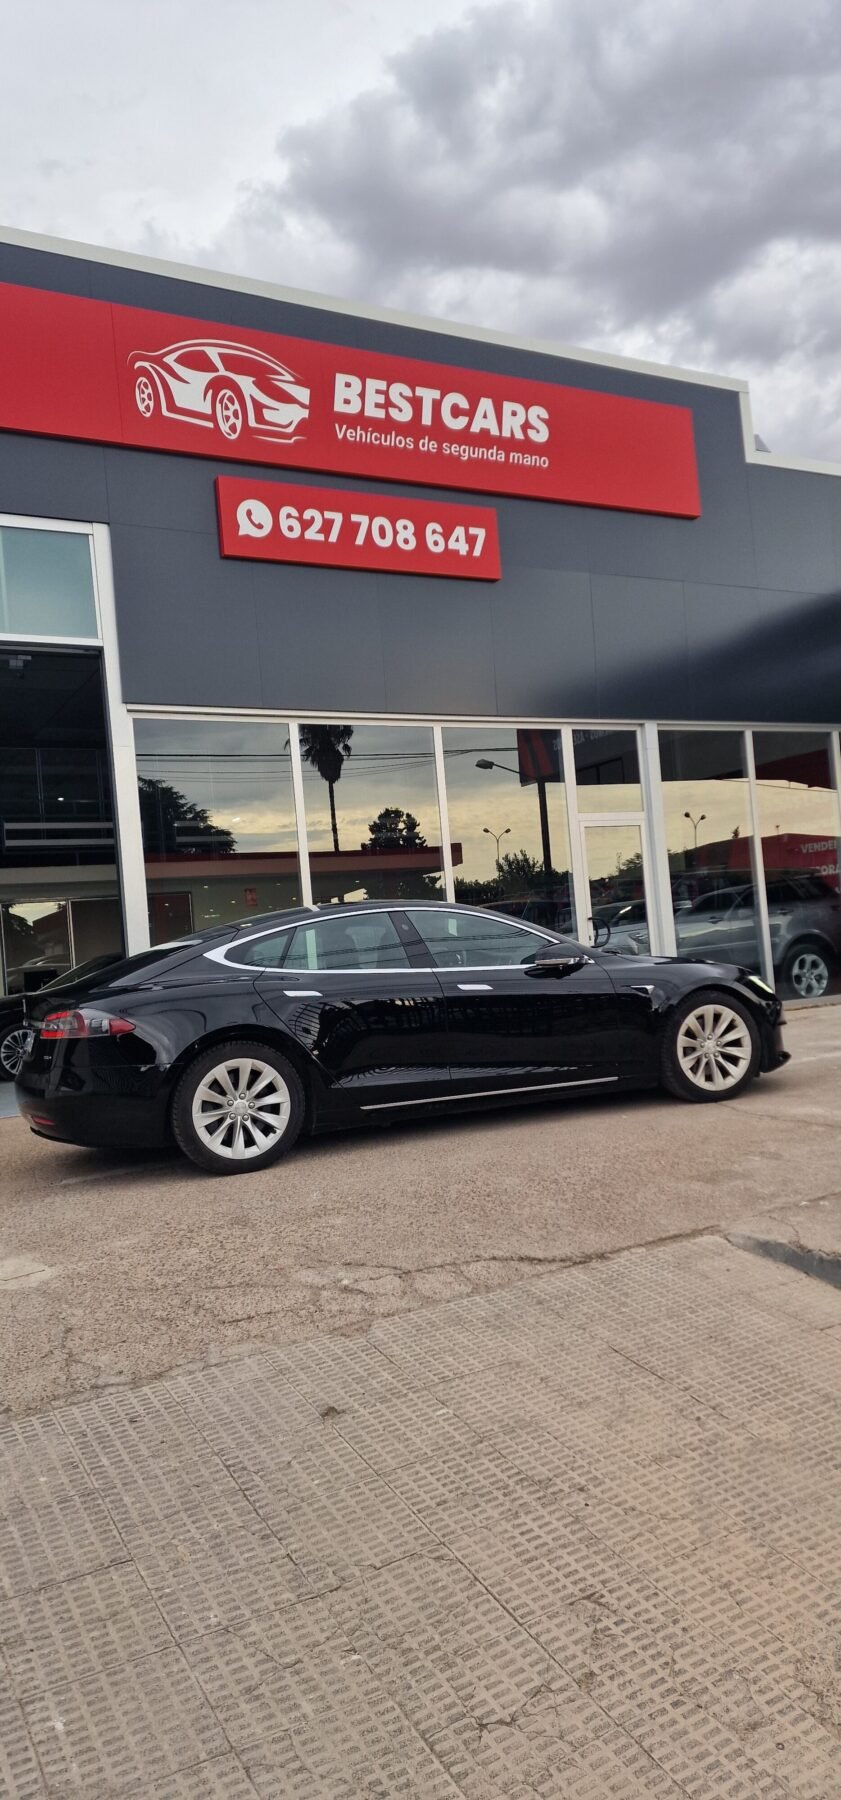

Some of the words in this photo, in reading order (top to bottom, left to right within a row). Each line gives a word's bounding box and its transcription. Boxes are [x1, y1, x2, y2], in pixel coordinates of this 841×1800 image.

[333, 373, 550, 443] BESTCARS
[334, 423, 415, 450] Vehículos
[418, 435, 438, 453] de
[442, 443, 506, 462] segunda
[509, 452, 549, 468] mano
[278, 505, 343, 543] 627
[350, 513, 417, 551] 708
[425, 522, 487, 558] 647
